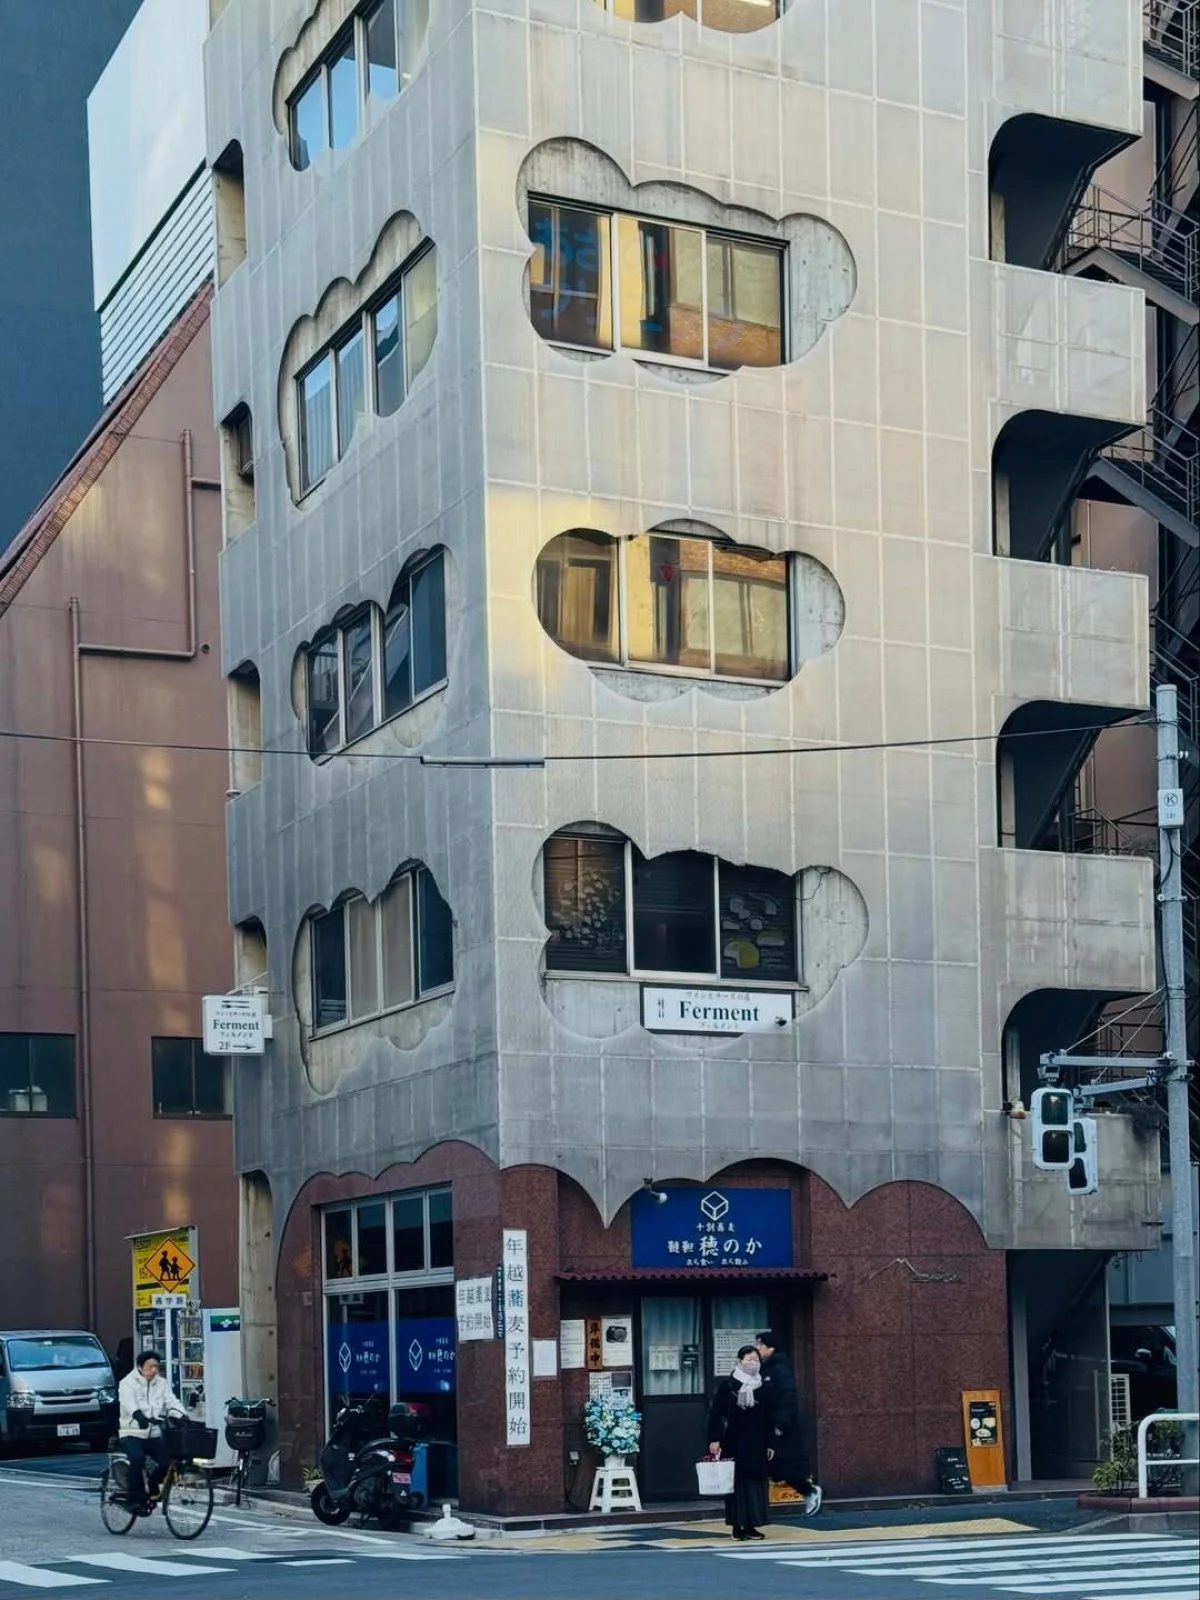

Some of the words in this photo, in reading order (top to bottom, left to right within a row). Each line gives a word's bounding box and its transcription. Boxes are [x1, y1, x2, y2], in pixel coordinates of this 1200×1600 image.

[680, 1000, 759, 1022] Ferment
[213, 1019, 259, 1030] Ferment
[219, 1041, 231, 1050] 2F
[505, 1237, 528, 1436] 年越蕎麦予約開始
